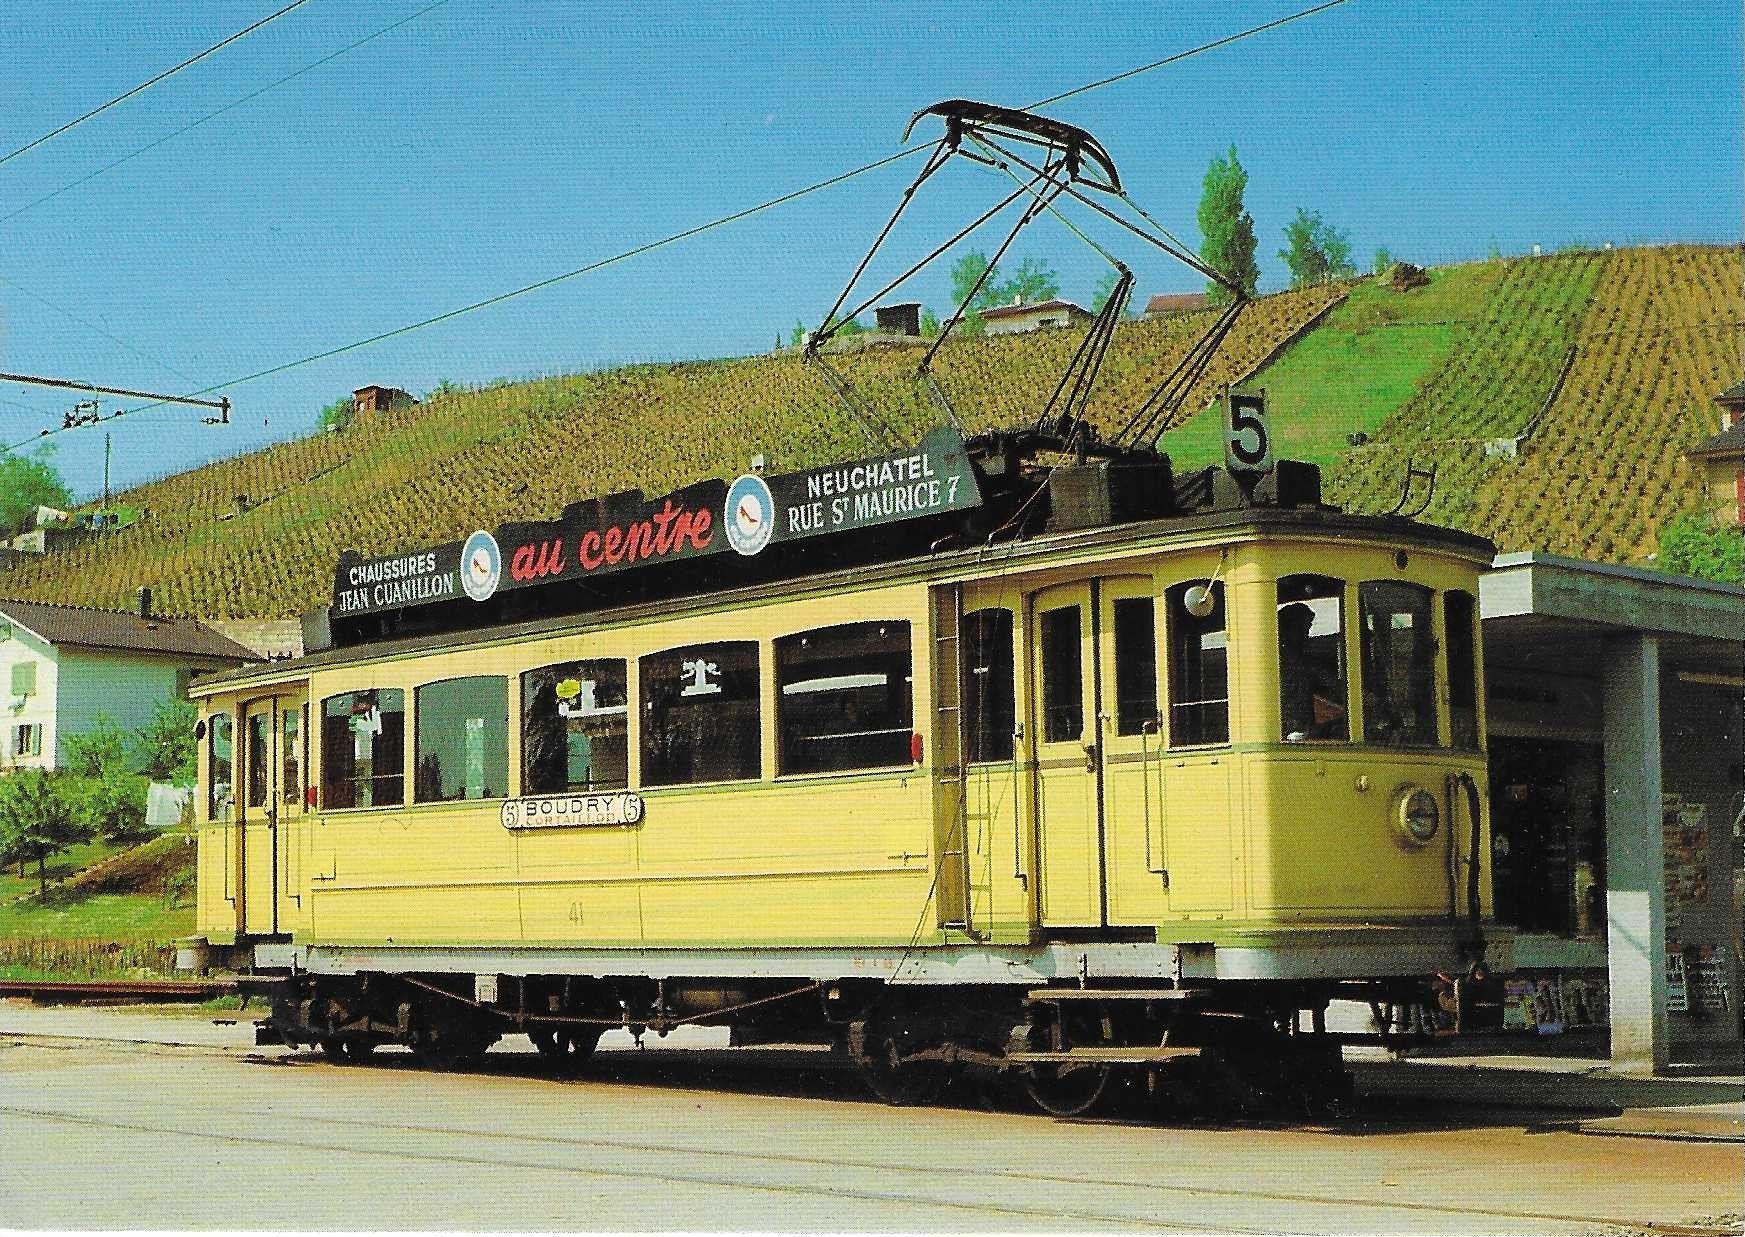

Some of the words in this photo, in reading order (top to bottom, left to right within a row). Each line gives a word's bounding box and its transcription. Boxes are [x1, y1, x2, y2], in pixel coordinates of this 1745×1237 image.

[1229, 395, 1267, 465] 5
[807, 454, 934, 497] NEUCHATEL
[788, 503, 824, 532] RUE
[852, 481, 941, 520] MAURICE
[946, 475, 961, 504] 7
[511, 538, 567, 582] au
[578, 499, 714, 571] centre
[349, 553, 436, 585] CHAUSSURES
[339, 588, 369, 612] JEAN
[374, 573, 454, 606] CUANILLON
[505, 804, 515, 827] 5
[526, 798, 614, 816] BOUDRY
[627, 798, 638, 820] 5
